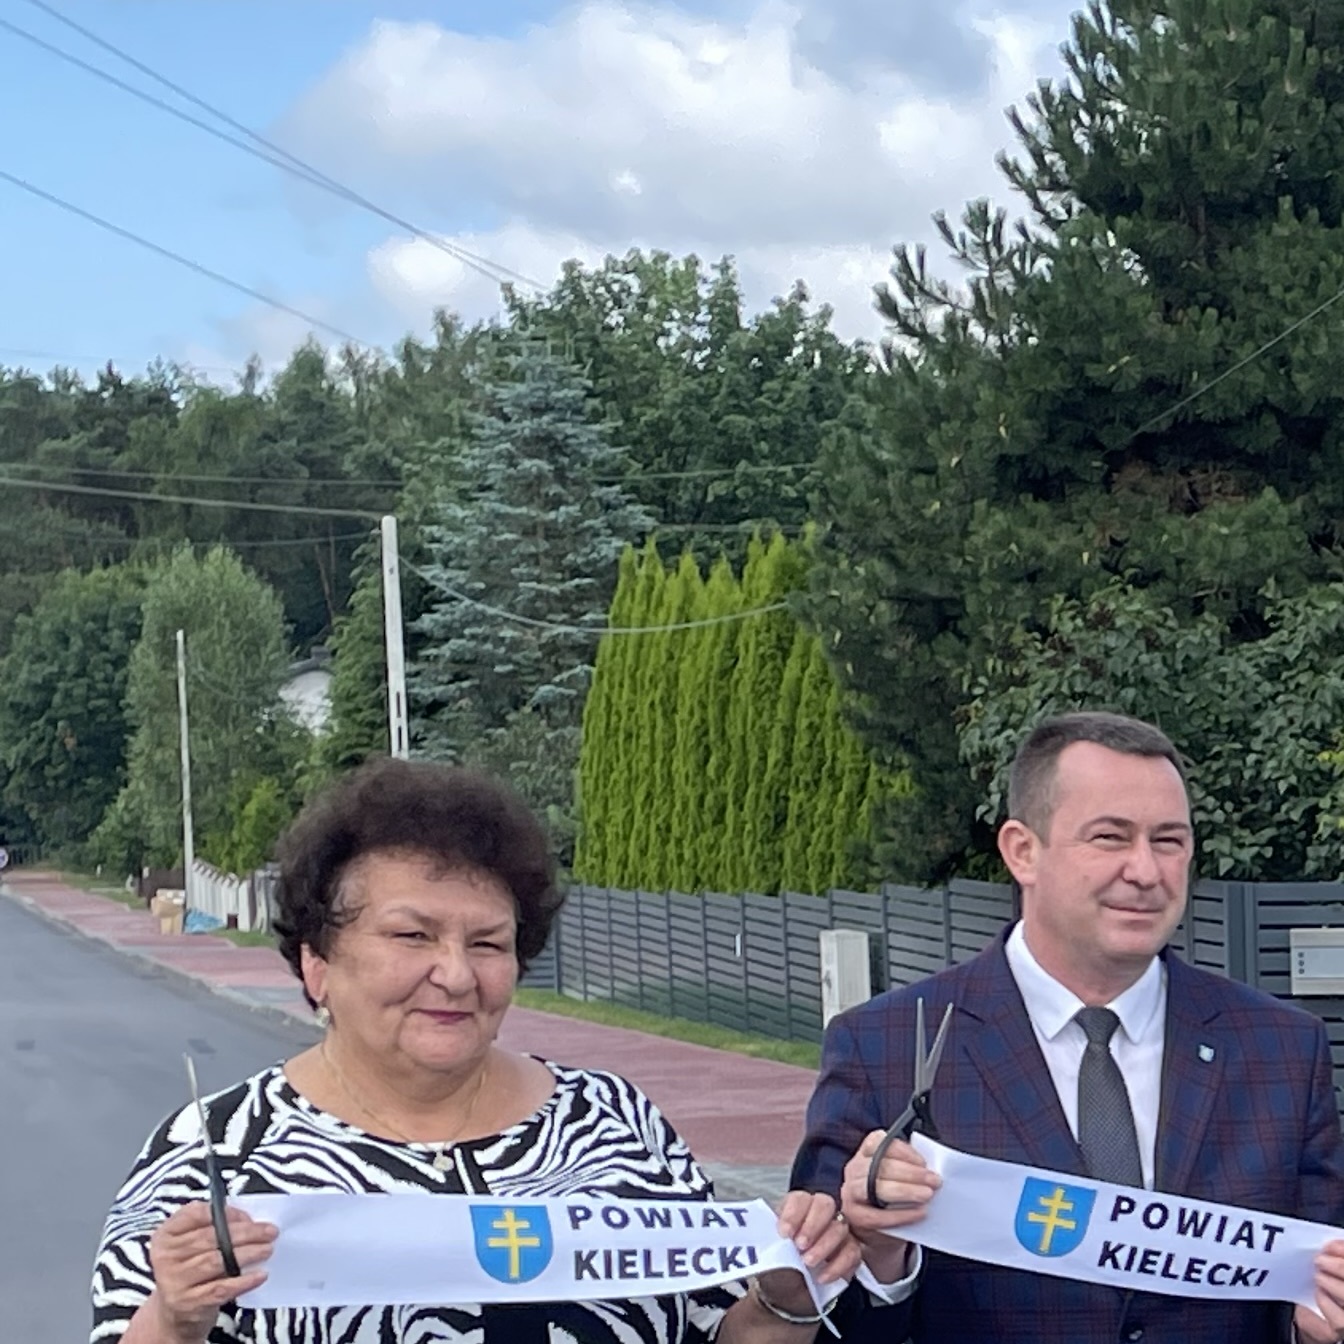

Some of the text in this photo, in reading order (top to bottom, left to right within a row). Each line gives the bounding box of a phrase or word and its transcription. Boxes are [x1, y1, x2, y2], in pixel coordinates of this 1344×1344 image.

[567, 1204, 750, 1231] POWIAT
[1109, 1194, 1285, 1253] POWIAT
[573, 1245, 759, 1281] KIELECKI
[1097, 1240, 1271, 1288] KIELECKI
